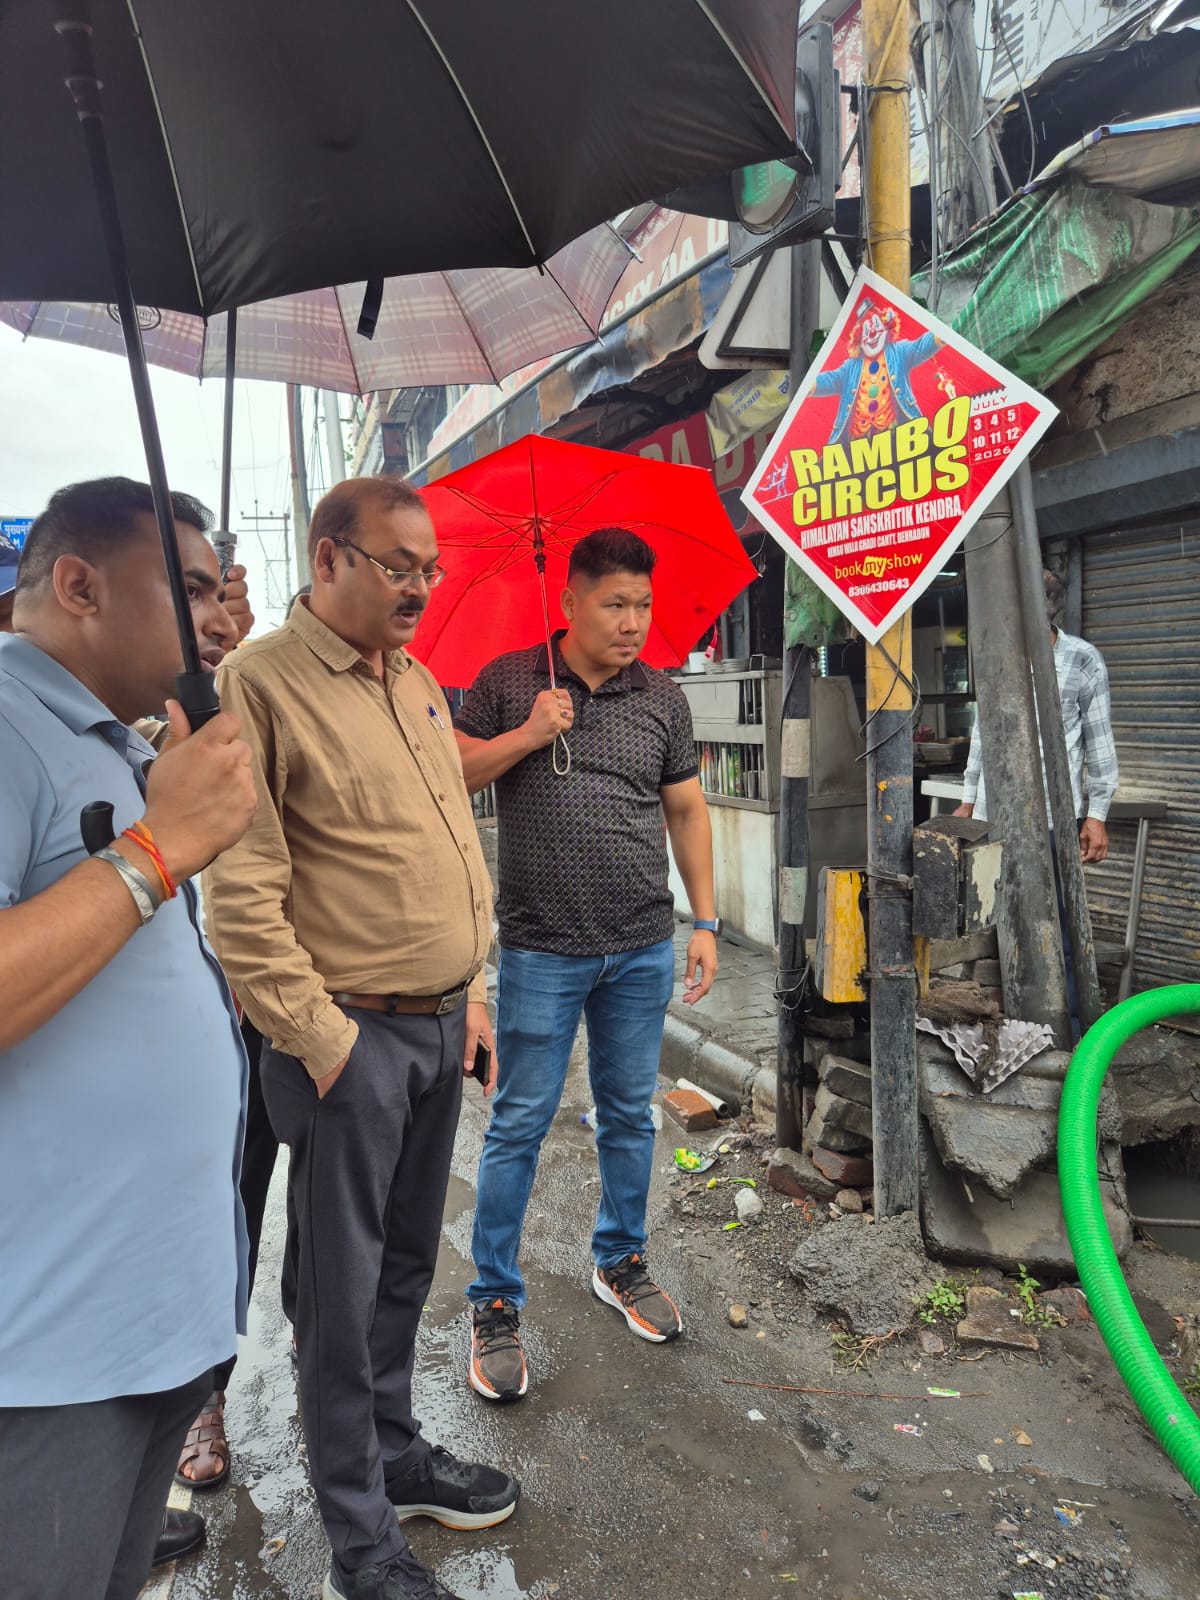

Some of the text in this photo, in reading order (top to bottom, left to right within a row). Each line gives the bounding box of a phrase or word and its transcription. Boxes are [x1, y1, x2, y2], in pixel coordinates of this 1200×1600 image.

[974, 395, 1007, 411] JULY
[974, 409, 1016, 431] 3 4 5
[789, 395, 971, 487] RAMBO
[972, 426, 1019, 449] 10 11 12
[974, 445, 1011, 461] 2026
[792, 445, 970, 526] CIRCUS
[800, 494, 965, 550] HIMALAYAN SANSKRITIK KENDRA,
